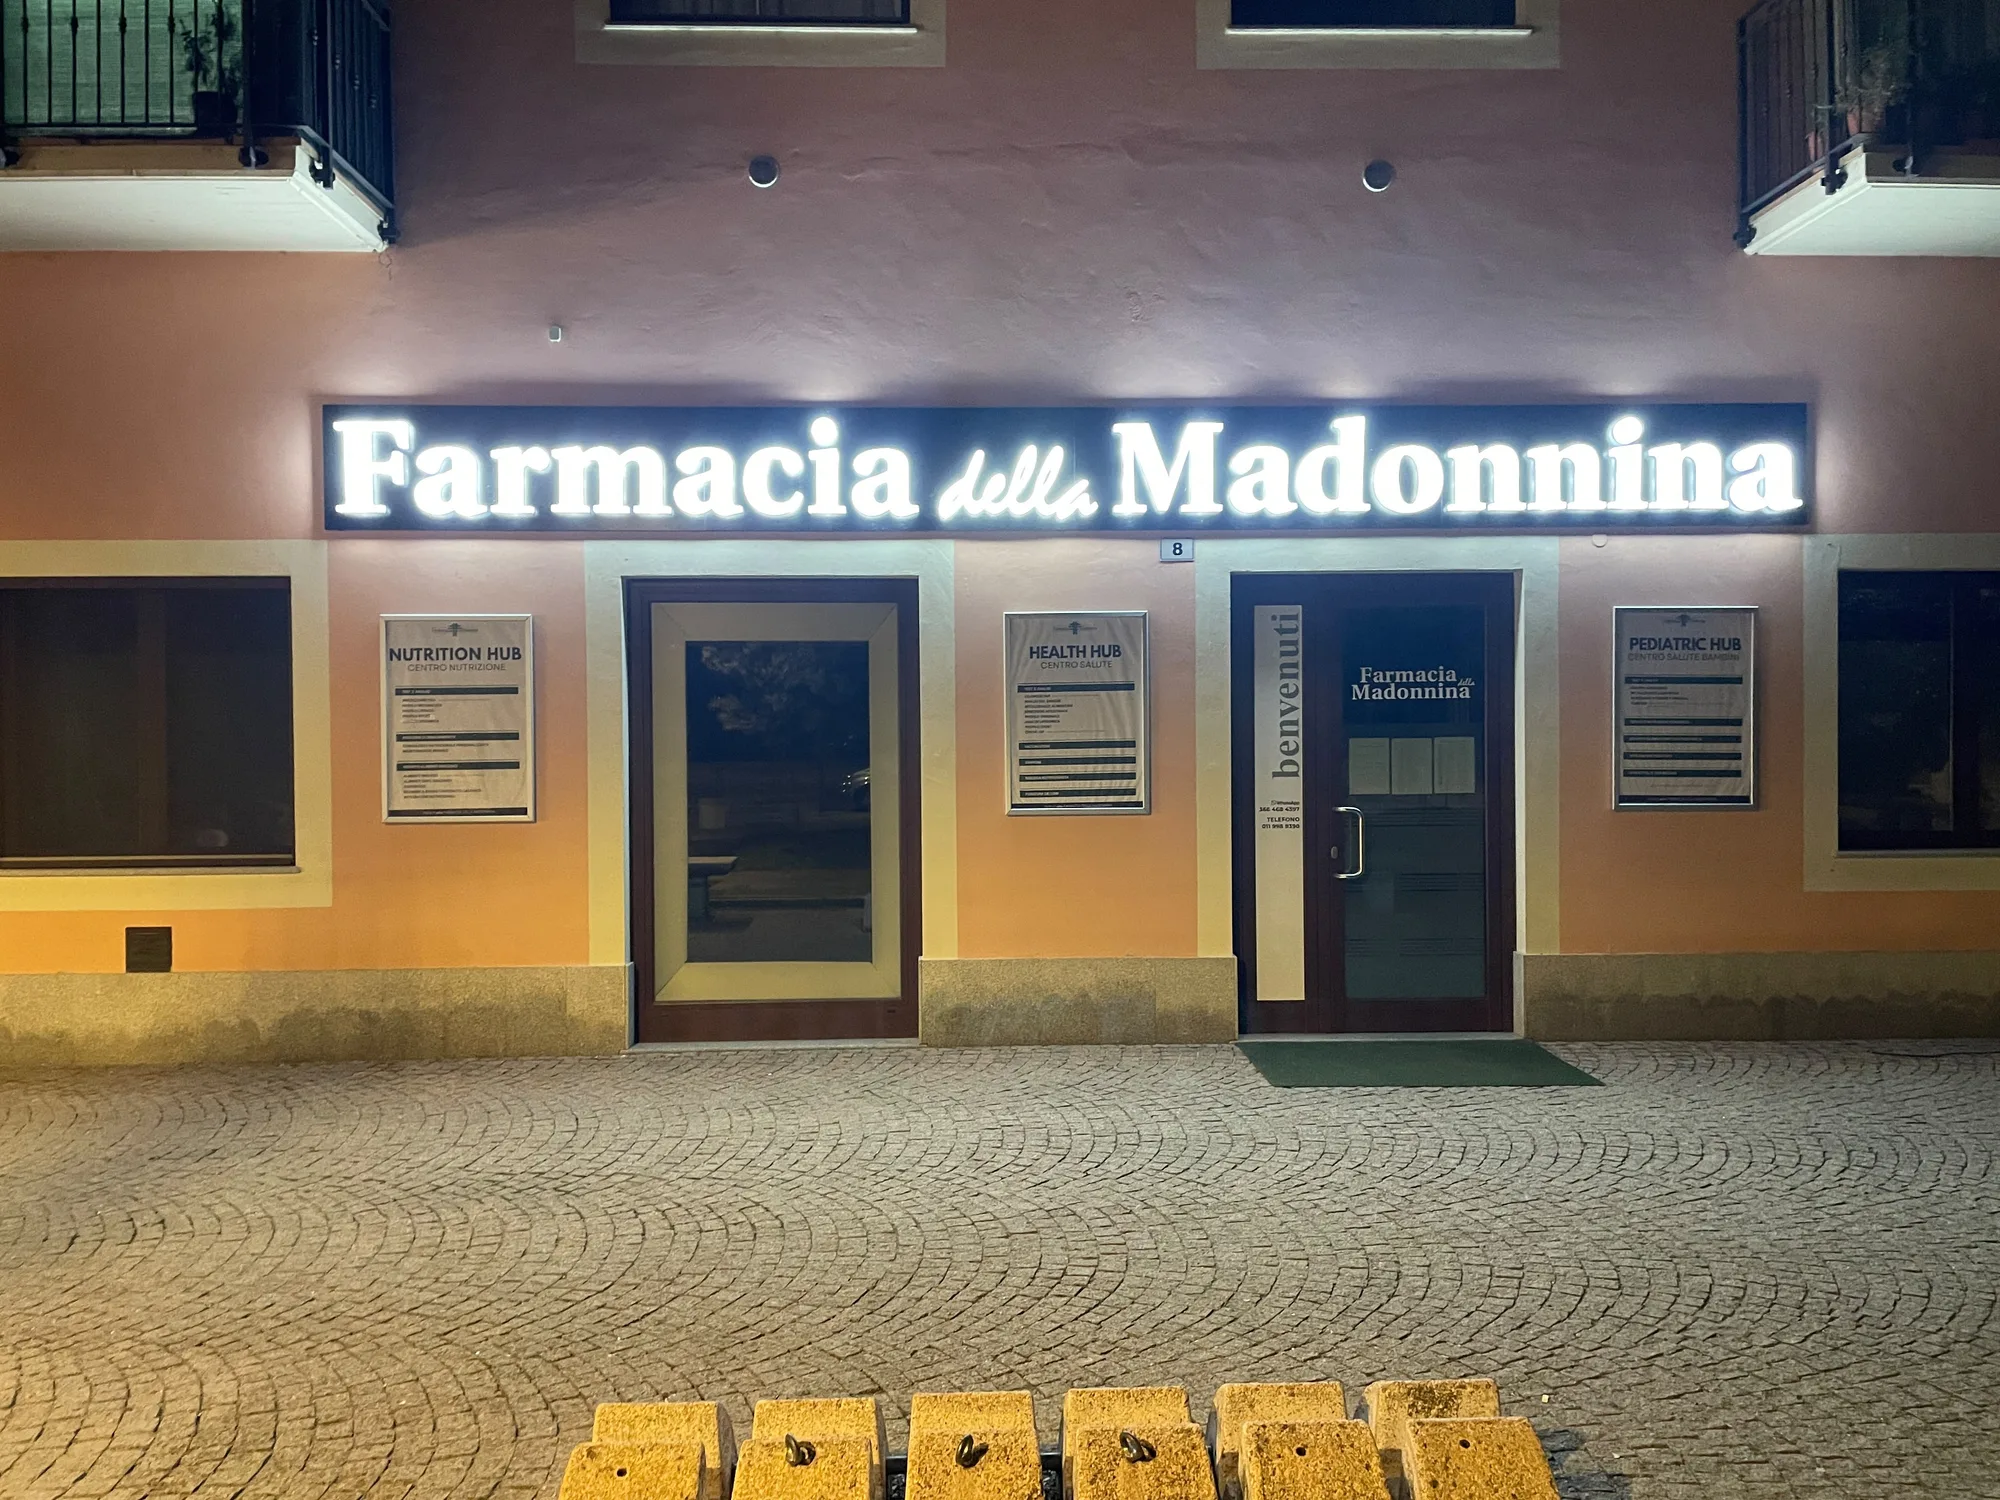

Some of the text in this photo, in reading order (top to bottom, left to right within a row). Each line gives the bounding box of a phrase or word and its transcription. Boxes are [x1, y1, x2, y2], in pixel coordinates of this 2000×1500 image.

[333, 415, 1803, 521] Farmacia della Madonnina
[1172, 542, 1183, 556] 8
[1629, 637, 1742, 651] PEDIATRIC HUB
[389, 647, 522, 662] NUTRITION HUB
[1029, 644, 1122, 660] HEALTH HUB
[1627, 653, 1740, 662] CENTRO SALUTE BAMBINI
[407, 663, 506, 672] CENTRO NUTRIZIONE
[1040, 660, 1113, 670] CENTRO SALUTE
[1359, 665, 1457, 683] Farmacia
[1271, 612, 1300, 779] benvenuti
[1351, 683, 1471, 700] Madonnina
